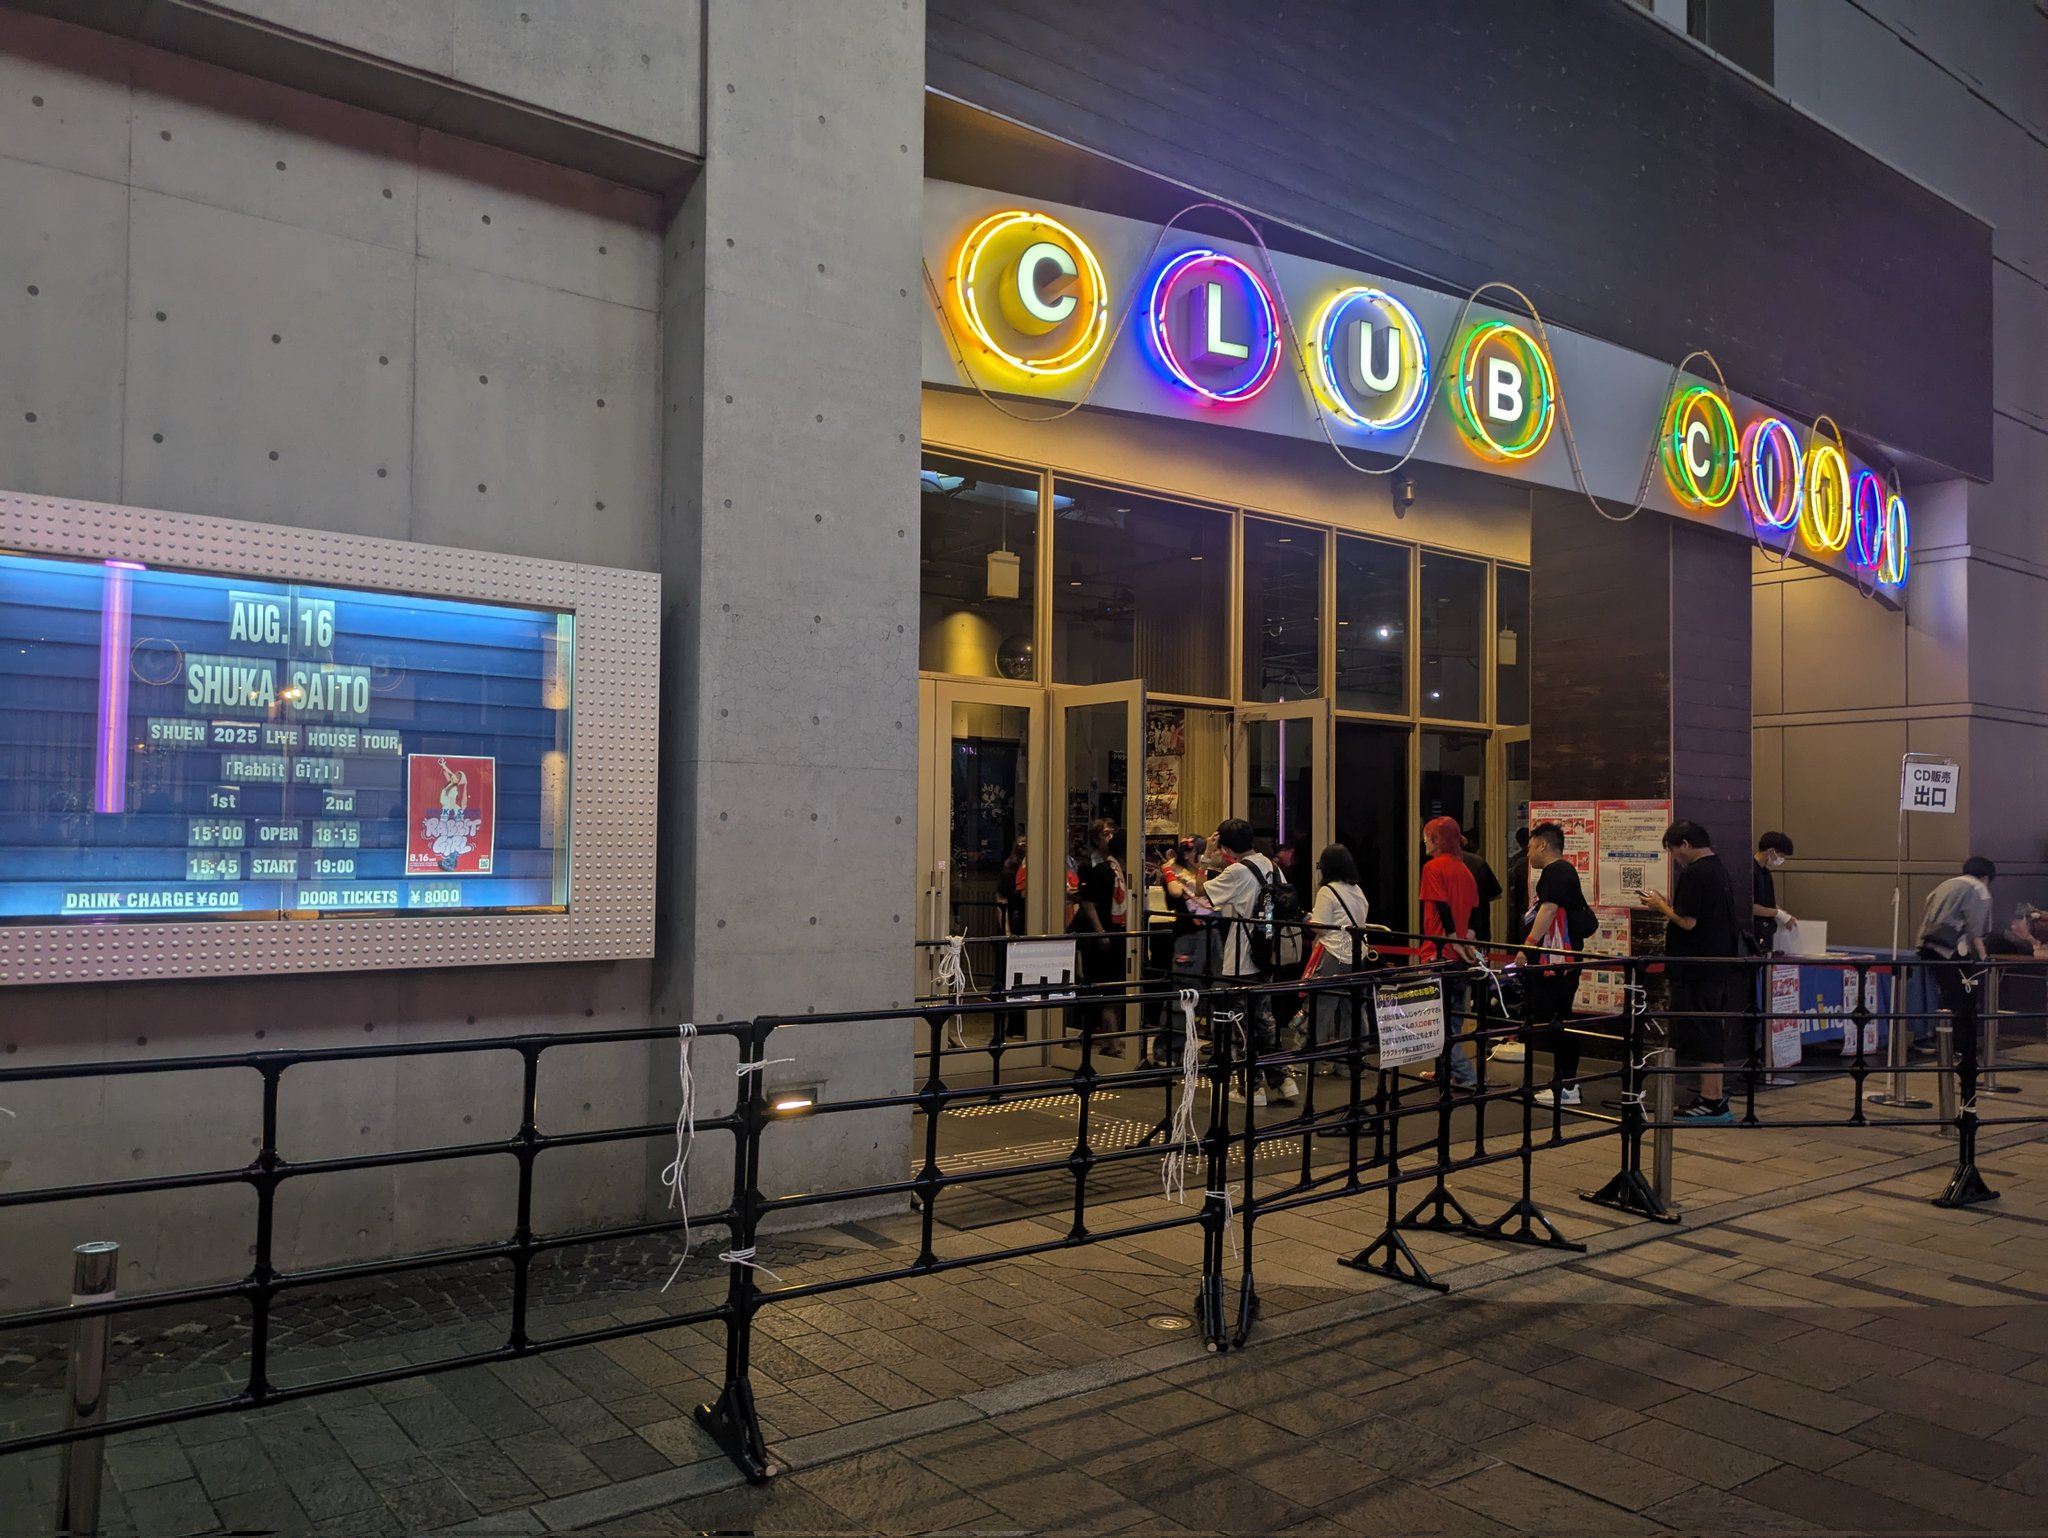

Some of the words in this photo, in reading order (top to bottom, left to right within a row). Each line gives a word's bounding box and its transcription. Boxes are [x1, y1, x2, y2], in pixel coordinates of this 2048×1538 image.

[1016, 242, 1524, 421] CLUB
[230, 602, 288, 644] AUG.
[301, 610, 333, 648] 16
[187, 663, 275, 707] SHUKA
[292, 671, 369, 714] SAITO
[151, 725, 205, 741] SHUEN
[214, 728, 257, 743] 2025
[266, 730, 298, 745] LIVE
[308, 732, 356, 748] HOUSE
[363, 735, 399, 750] TOUR
[1914, 769, 1951, 783] CD販売
[211, 793, 236, 808] 1st
[325, 796, 353, 811] 2nd
[1914, 785, 1947, 807] 出口
[192, 825, 243, 841] 15:00
[260, 826, 299, 841] OPEN
[315, 827, 358, 843] 18:15
[190, 859, 238, 875] 15:45
[253, 859, 297, 874] START
[314, 859, 354, 874] 19:00
[409, 853, 429, 862] 8.16
[66, 893, 121, 909] DRINK
[300, 890, 338, 906] DOOR
[341, 889, 398, 905] TICKETS
